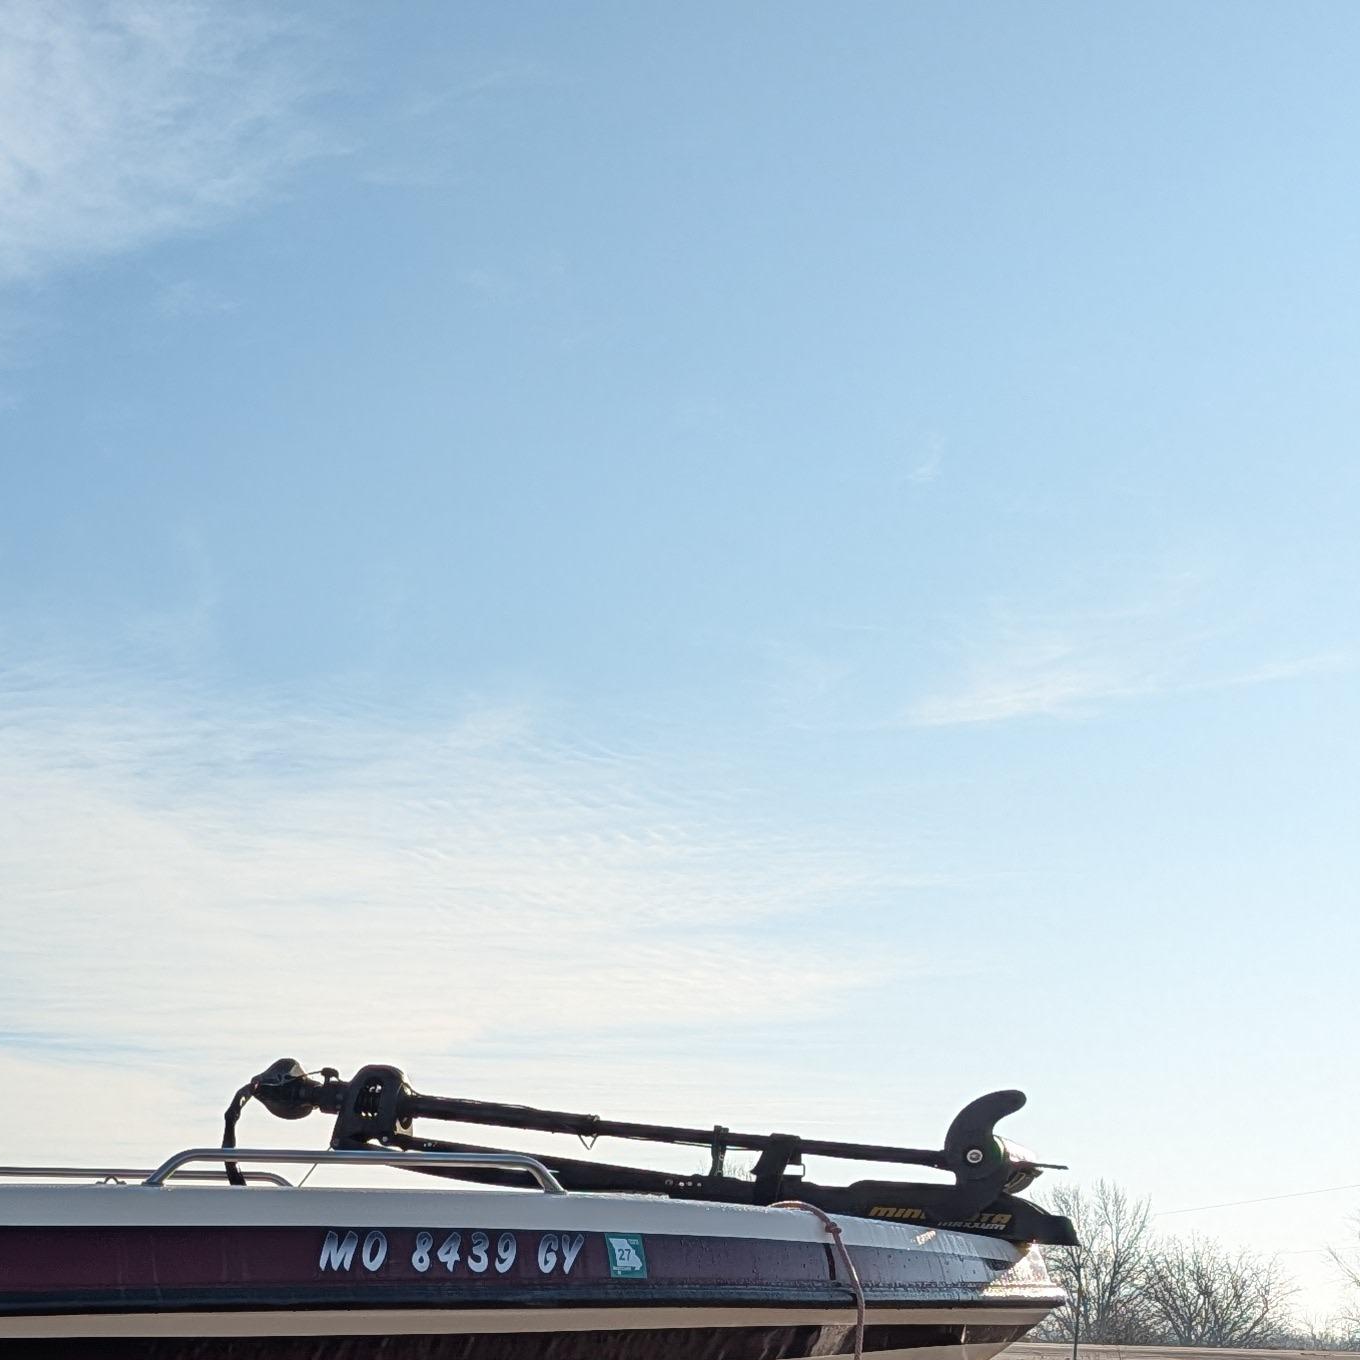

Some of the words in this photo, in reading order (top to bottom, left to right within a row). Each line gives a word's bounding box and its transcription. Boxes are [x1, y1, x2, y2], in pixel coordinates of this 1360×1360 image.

[319, 1230, 388, 1272] MO
[411, 1231, 517, 1273] 8439
[537, 1233, 585, 1275] GY
[617, 1248, 631, 1262] 27
